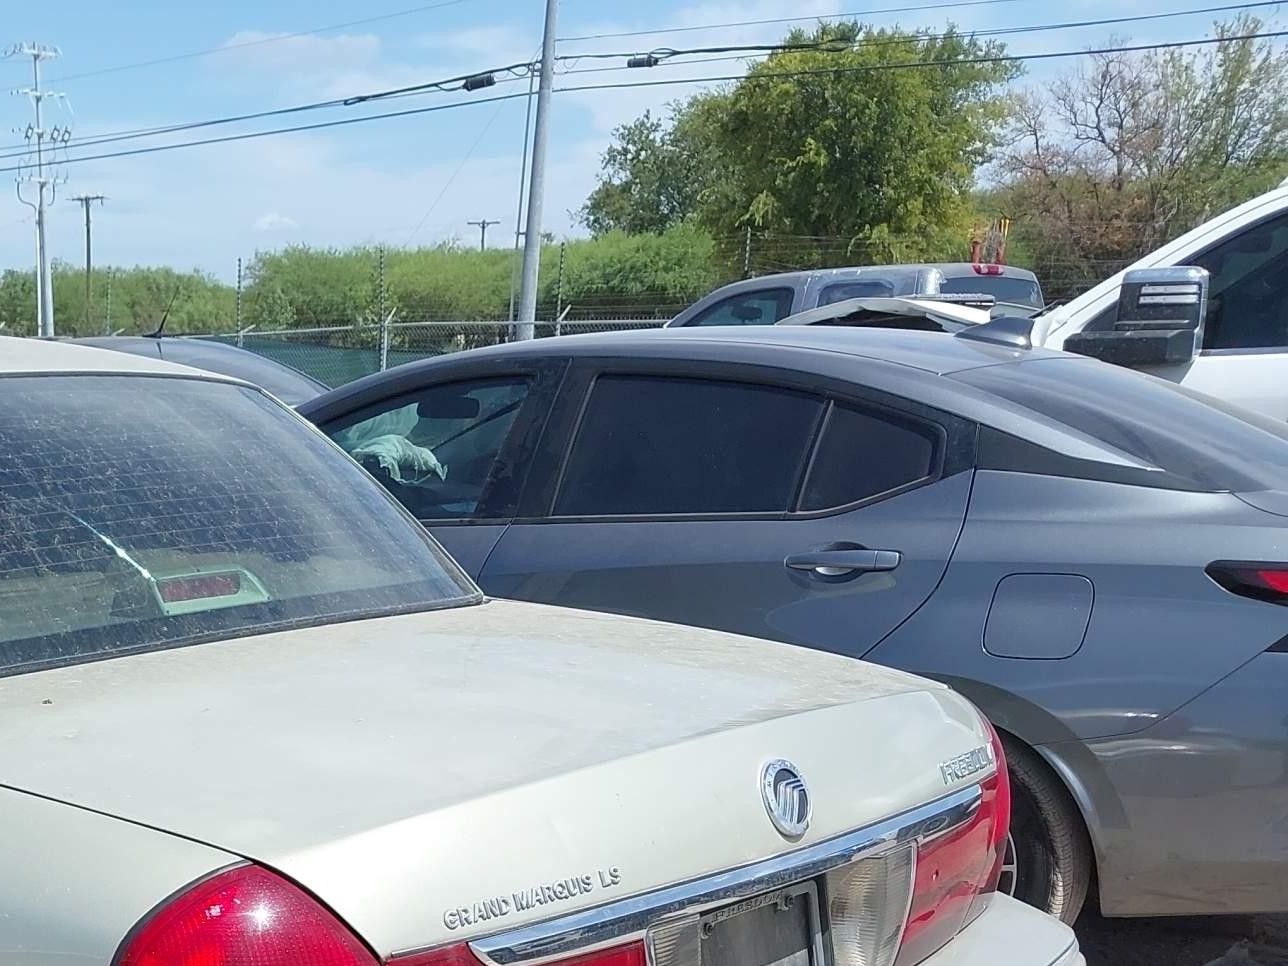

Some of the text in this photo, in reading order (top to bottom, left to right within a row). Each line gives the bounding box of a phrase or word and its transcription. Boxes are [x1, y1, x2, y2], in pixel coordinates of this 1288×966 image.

[443, 865, 622, 930] GRAND MARQUIS LS
